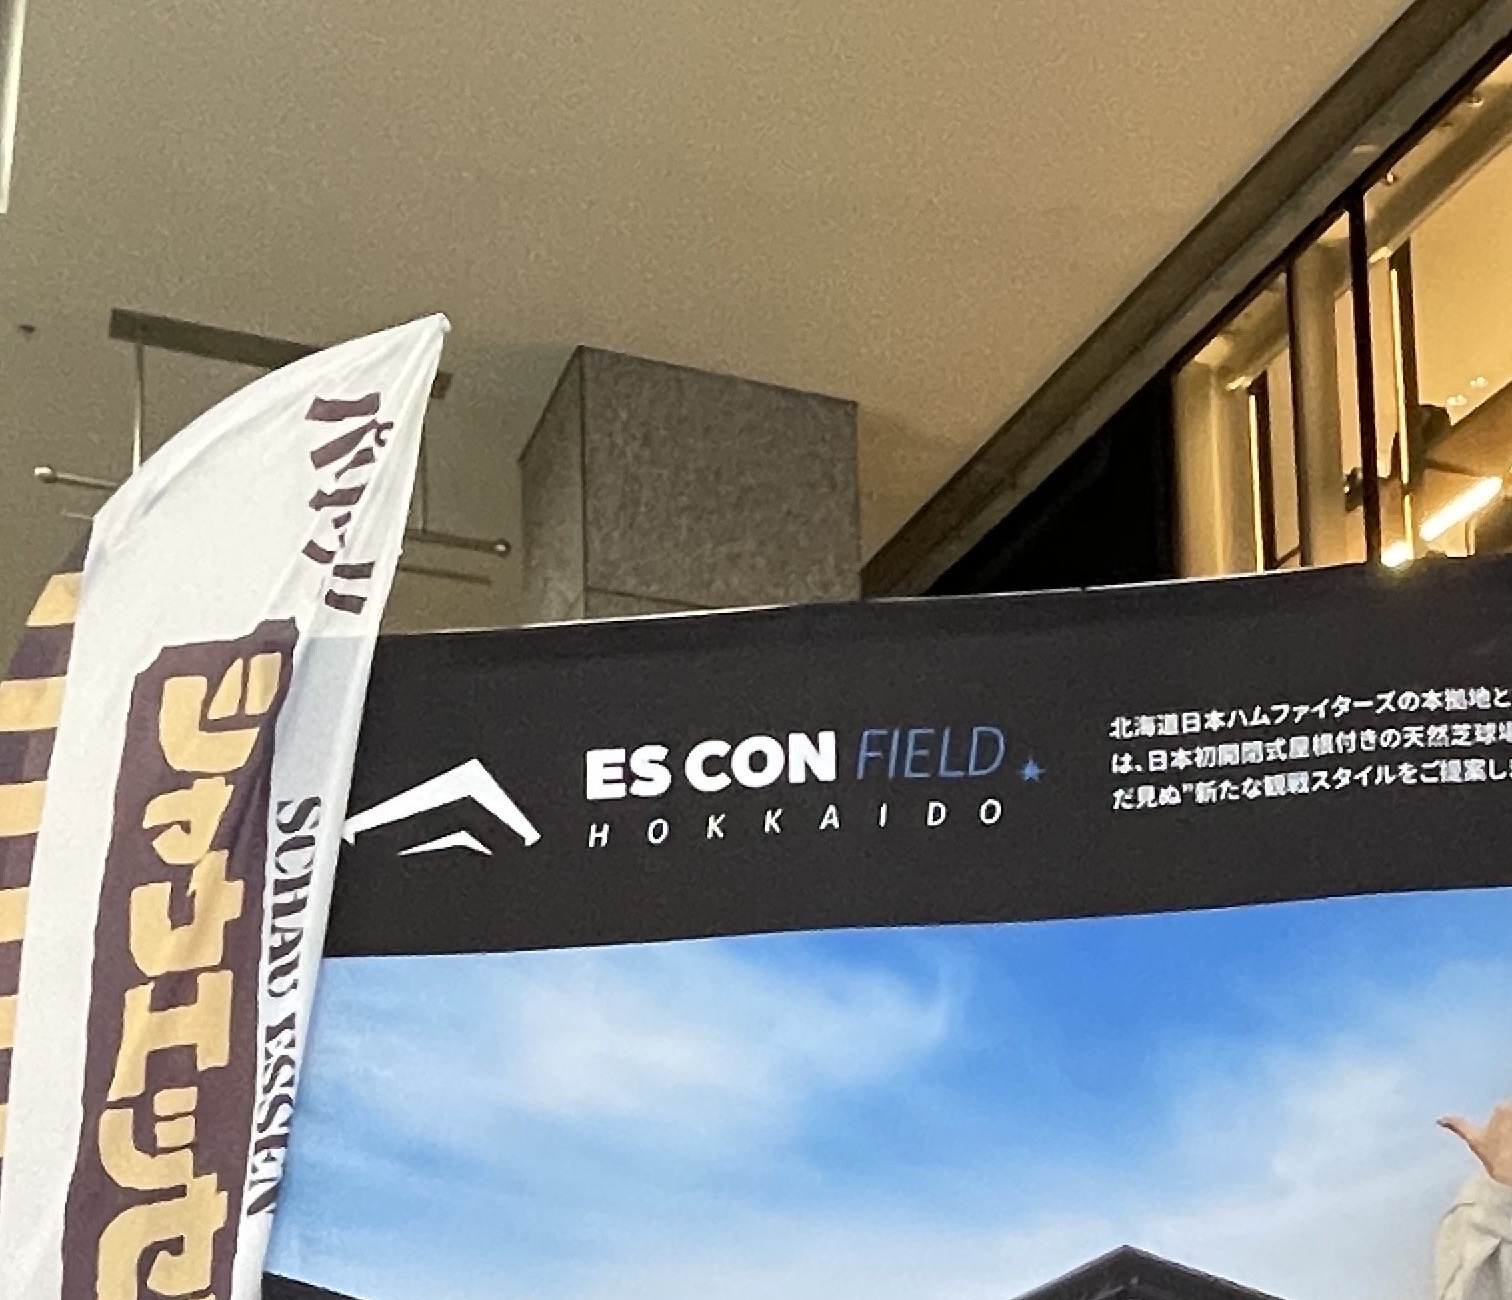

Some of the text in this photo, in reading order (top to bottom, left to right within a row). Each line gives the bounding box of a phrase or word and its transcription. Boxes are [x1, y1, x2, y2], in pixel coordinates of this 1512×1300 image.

[586, 725, 1006, 801] ES CON FIELD
[587, 799, 1002, 848] HOKKAIDO
[247, 796, 321, 1216] SCHAU ESSEN
